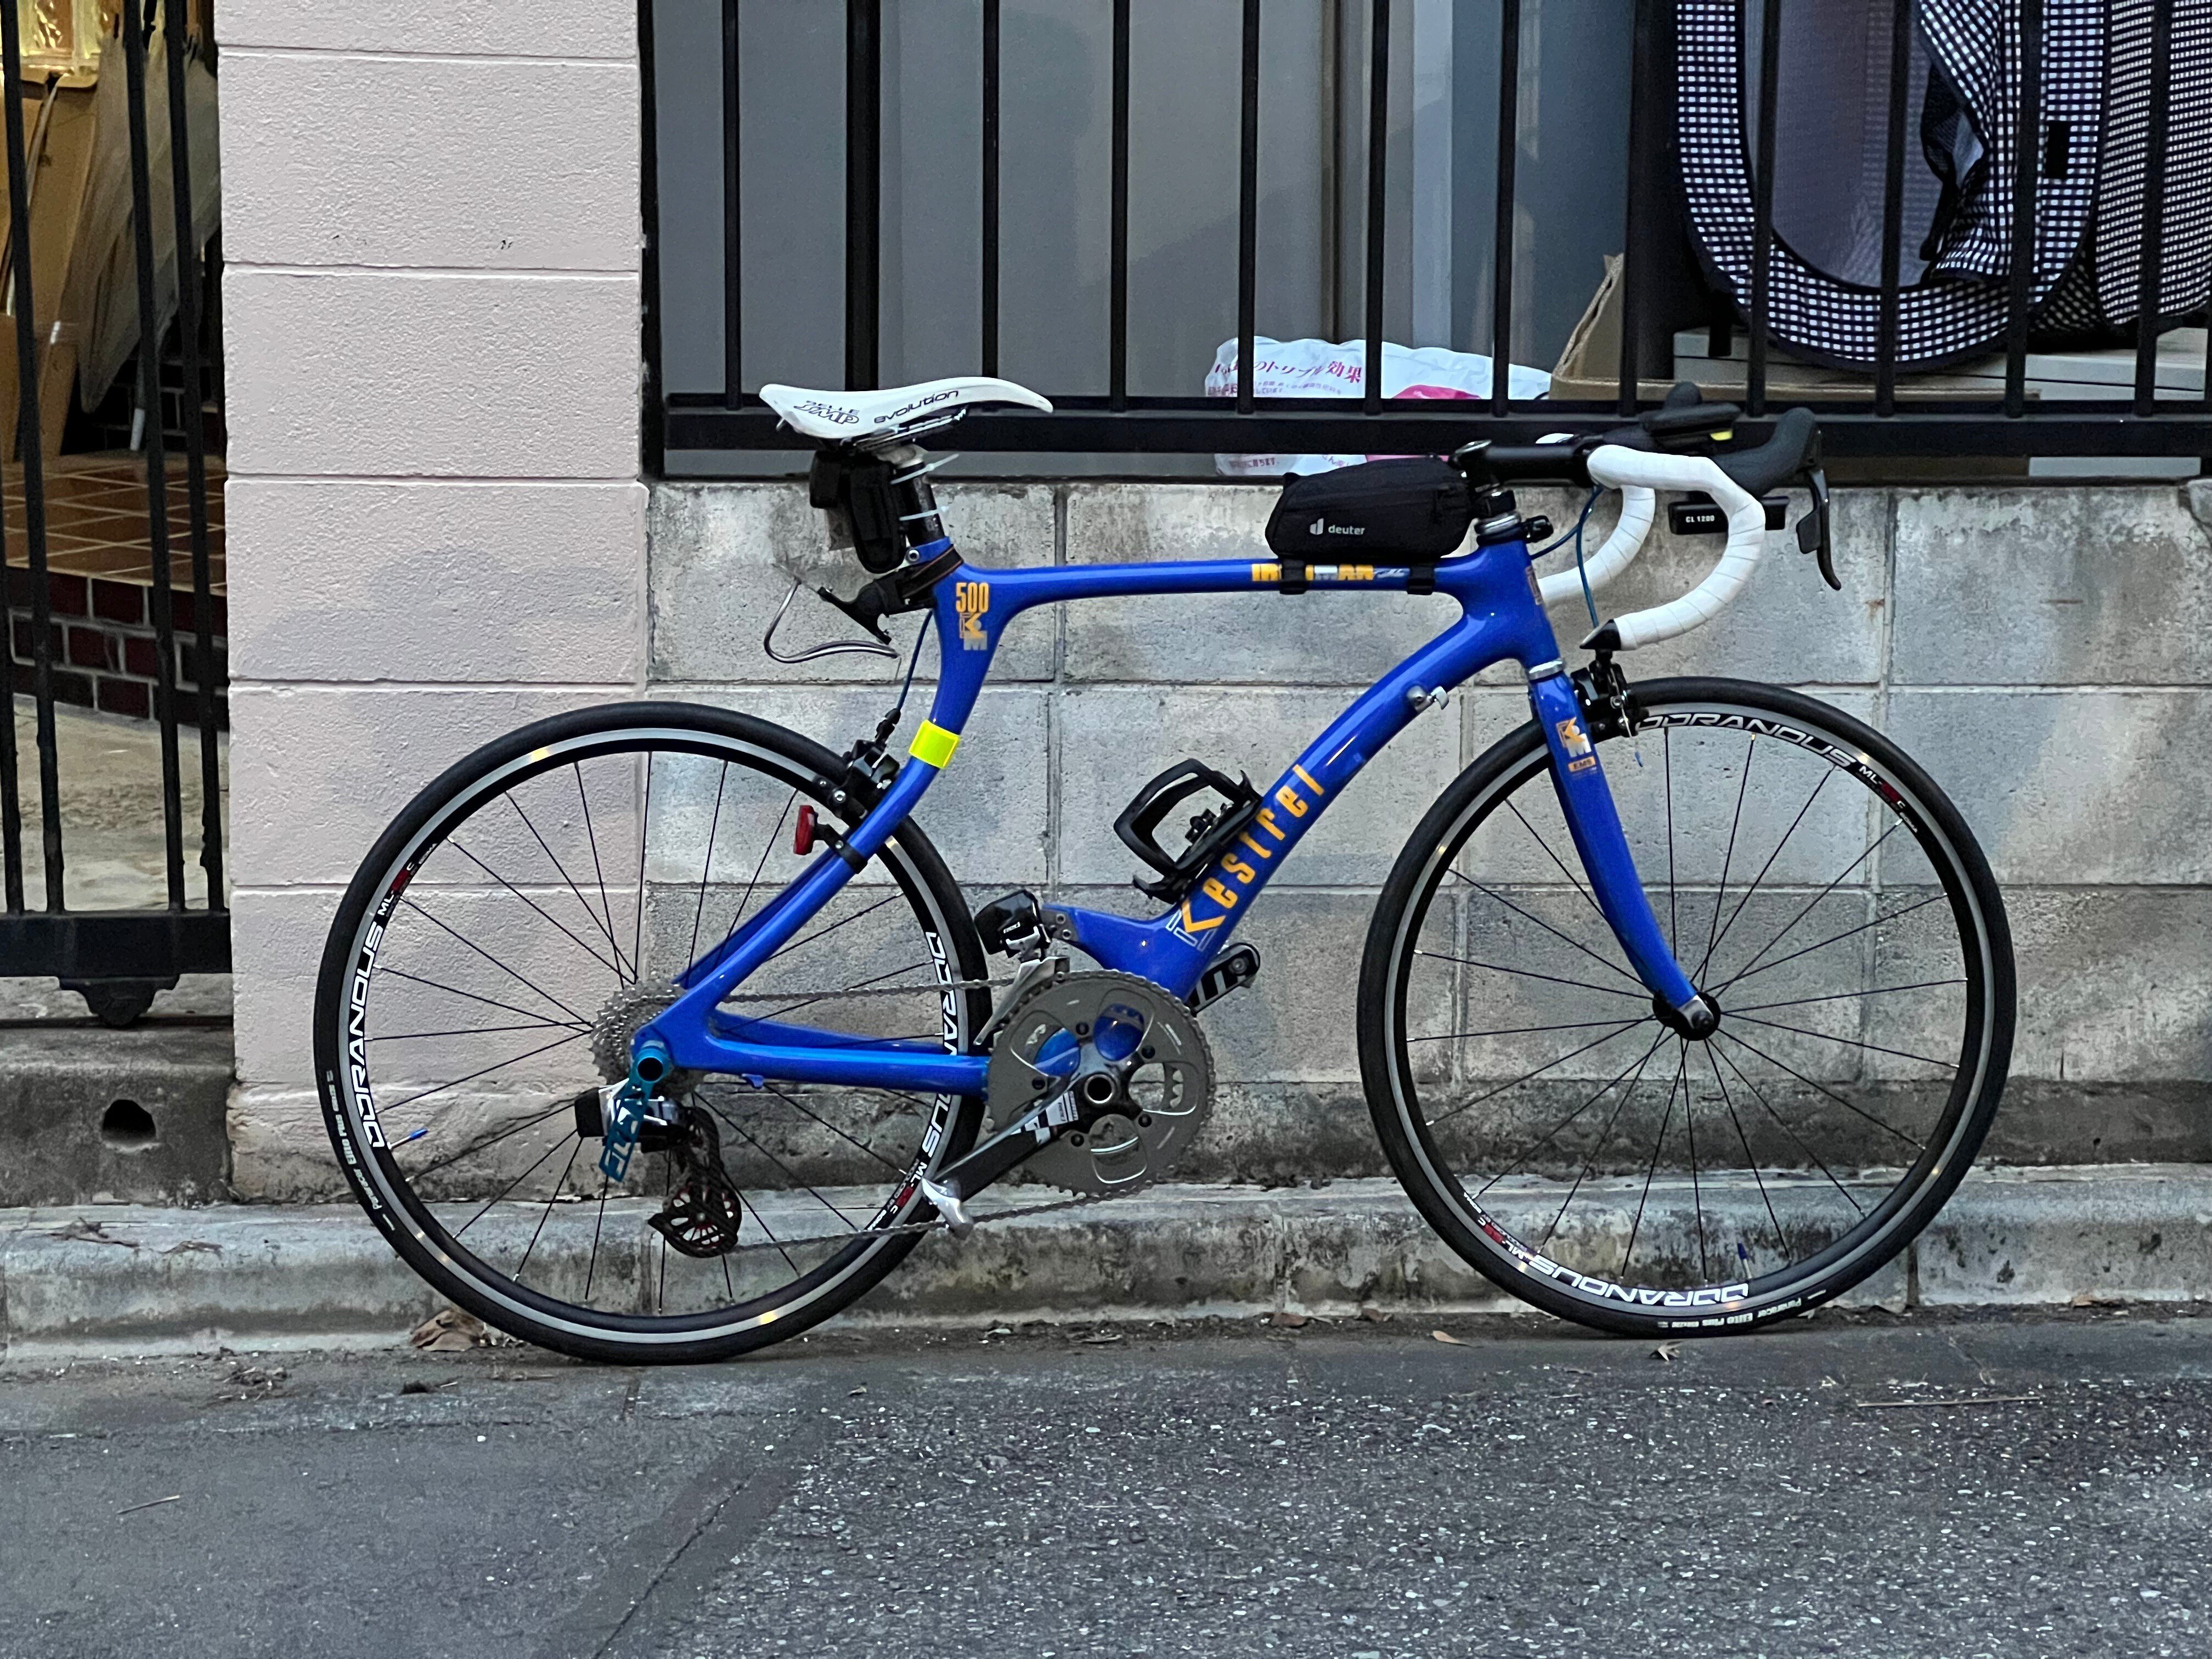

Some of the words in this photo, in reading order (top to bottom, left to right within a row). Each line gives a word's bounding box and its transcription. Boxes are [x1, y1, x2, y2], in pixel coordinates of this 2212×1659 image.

[874, 390, 959, 424] evolution
[1328, 524, 1365, 535] deuter
[956, 582, 989, 613] 500
[1167, 764, 1325, 951] Kestrel
